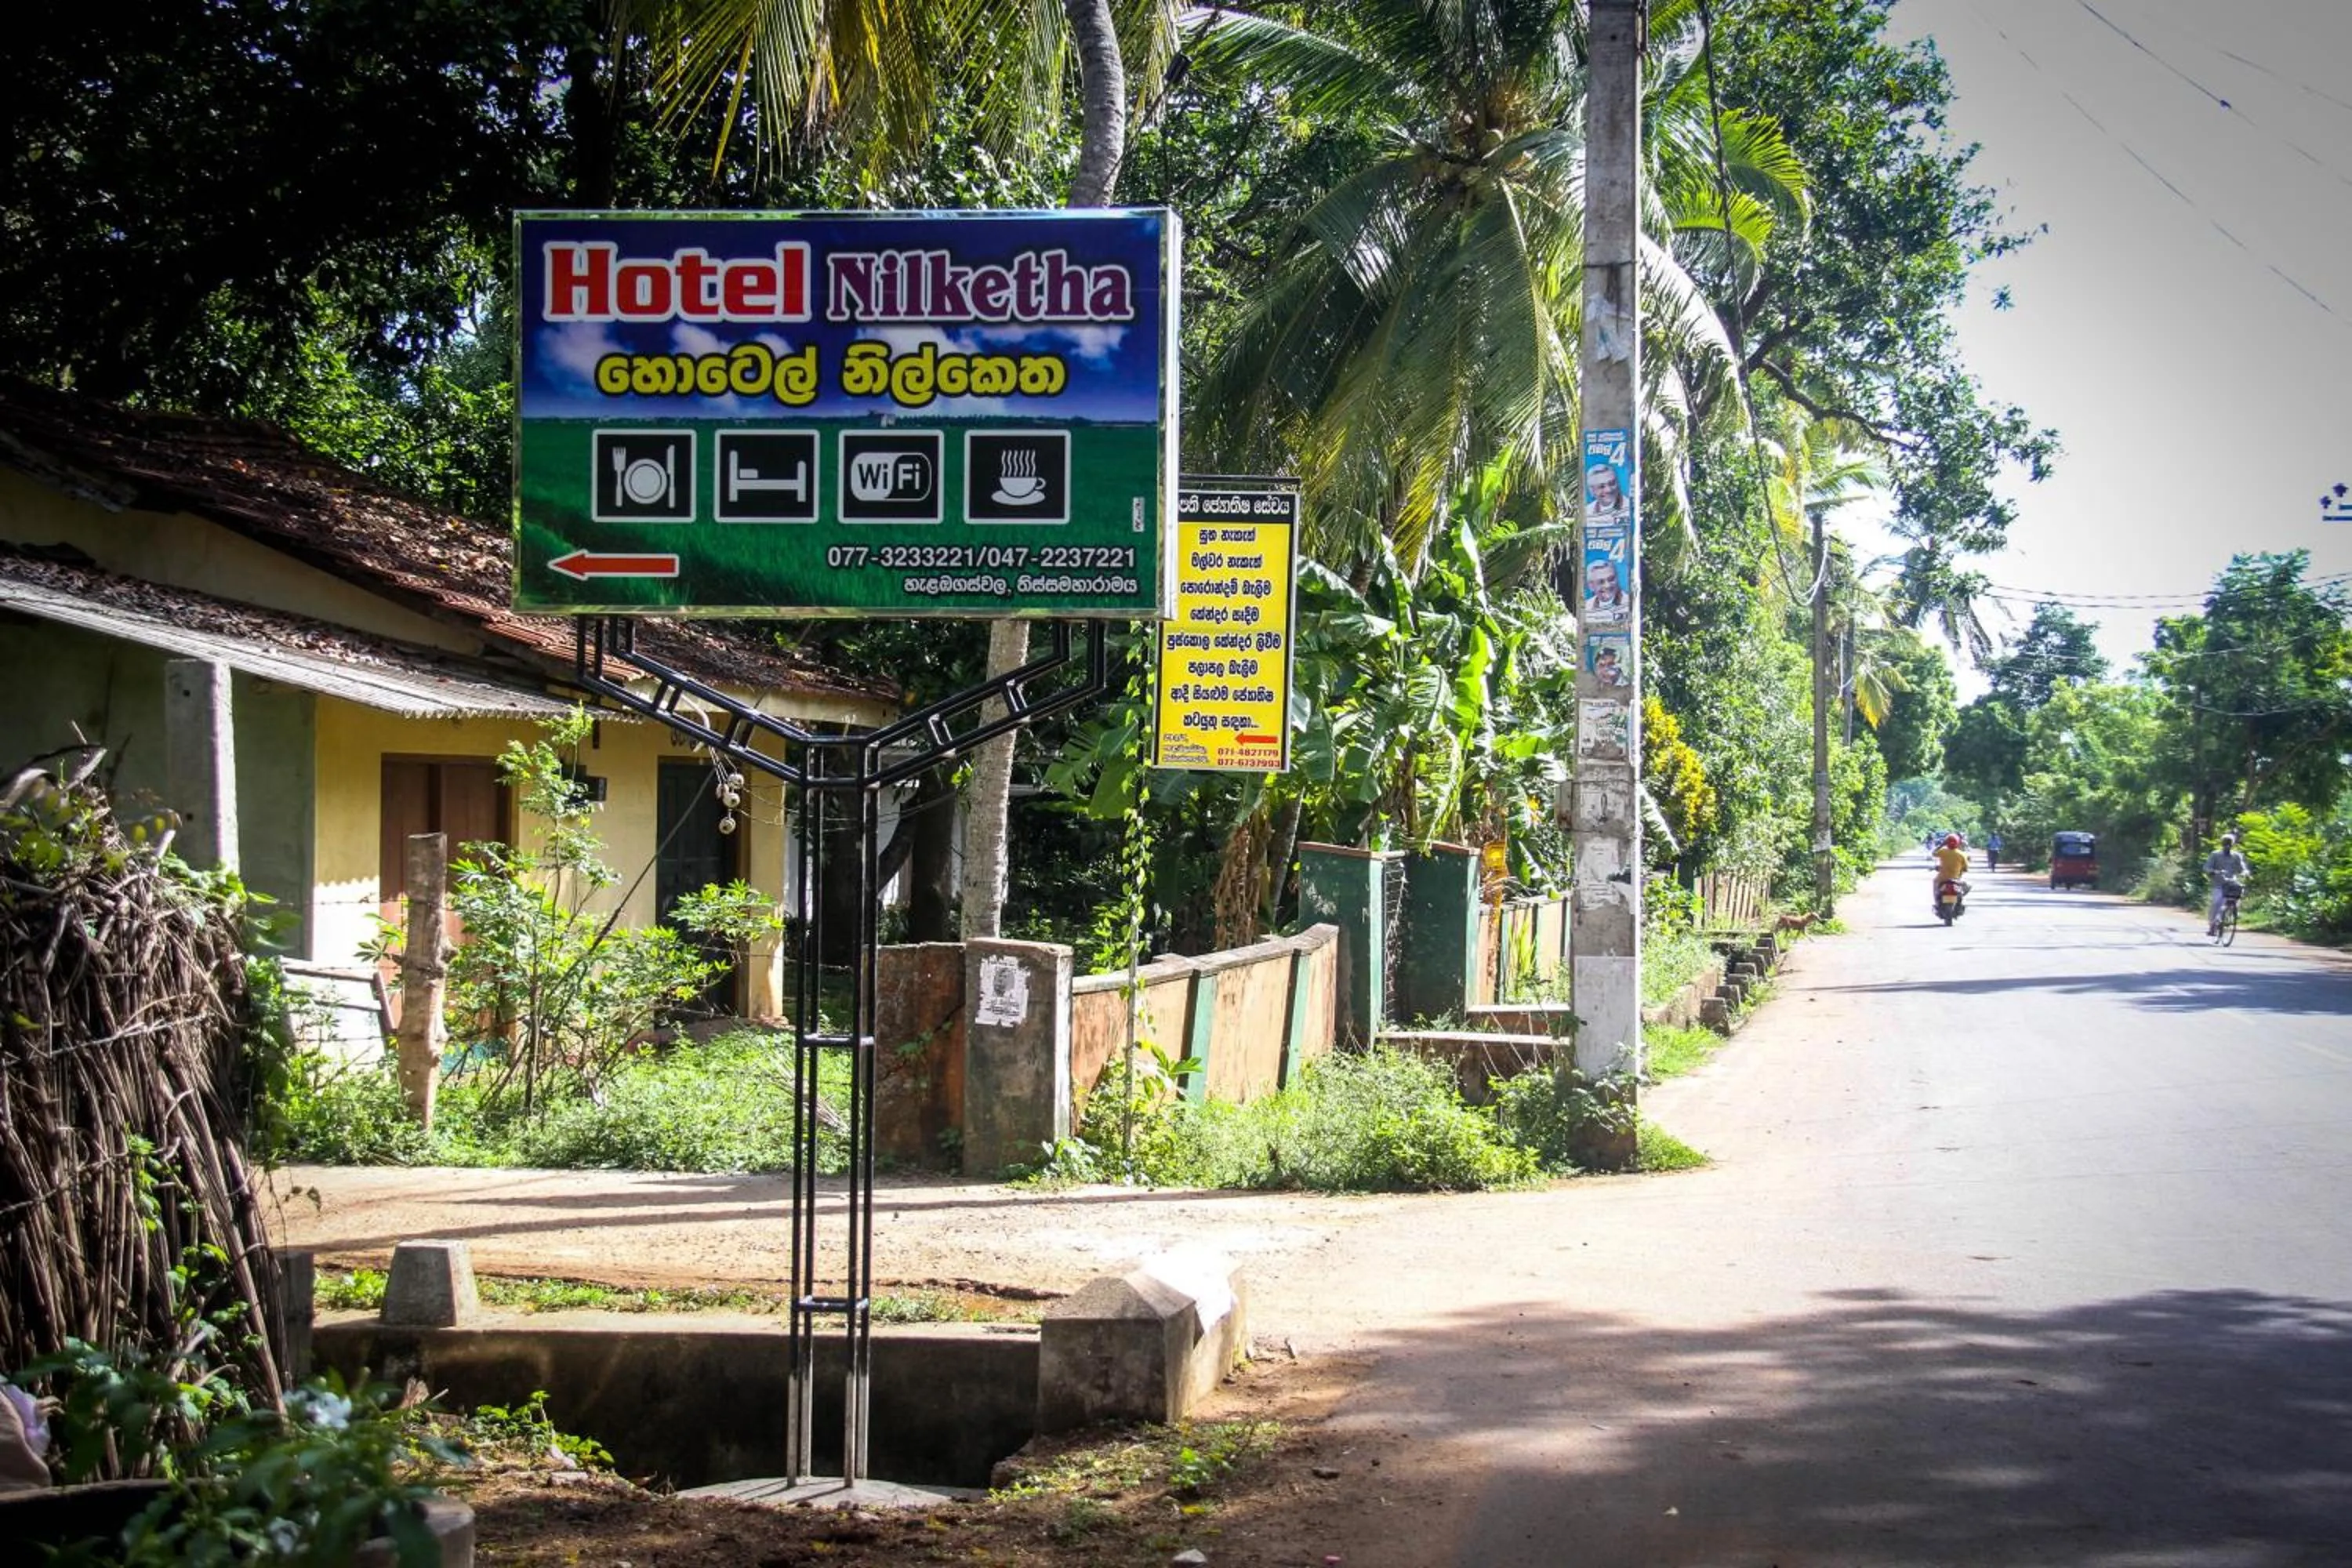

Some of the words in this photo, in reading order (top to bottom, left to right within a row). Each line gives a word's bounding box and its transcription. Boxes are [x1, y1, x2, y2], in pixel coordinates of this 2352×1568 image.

[543, 241, 811, 323] Hotel
[826, 249, 1133, 323] Nilketha
[596, 343, 818, 406] හොටෙල්
[843, 342, 1066, 407] නිල්කෙත
[1609, 442, 1626, 466] 4
[856, 461, 922, 494] WiFi
[1254, 495, 1290, 514] සේවය
[827, 546, 1135, 568] 077-3233221/047-2237221
[1608, 538, 1625, 562] 4
[1017, 575, 1138, 593] තිස්සමහාරාමය
